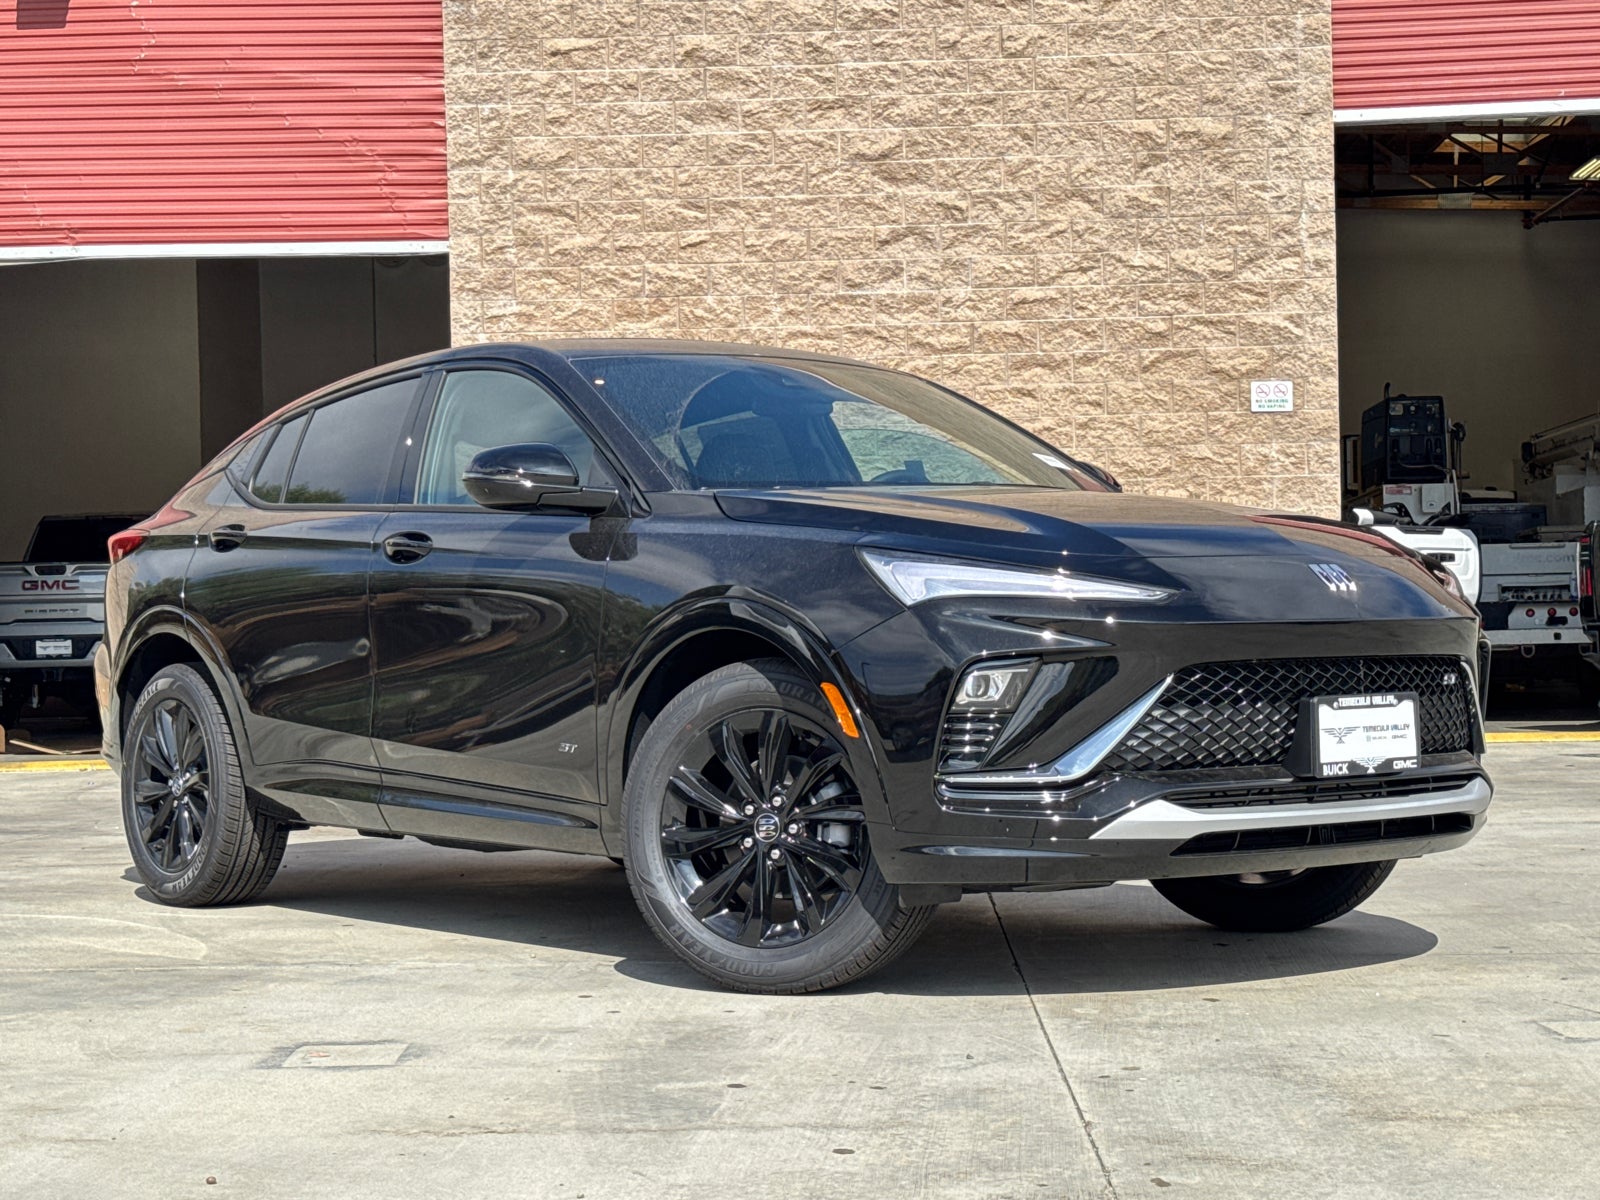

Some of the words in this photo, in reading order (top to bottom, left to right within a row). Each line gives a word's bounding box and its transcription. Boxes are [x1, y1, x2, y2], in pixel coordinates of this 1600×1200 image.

[22, 579, 80, 591] GMC
[1338, 696, 1371, 706] TEMECULA
[1372, 695, 1394, 705] VALLEY
[1362, 724, 1389, 733] TEMECULA
[1390, 723, 1410, 732] VALLEY
[1323, 763, 1349, 776] BUICK
[1393, 759, 1417, 769] GMC
[668, 923, 777, 976] GOODYEAR
